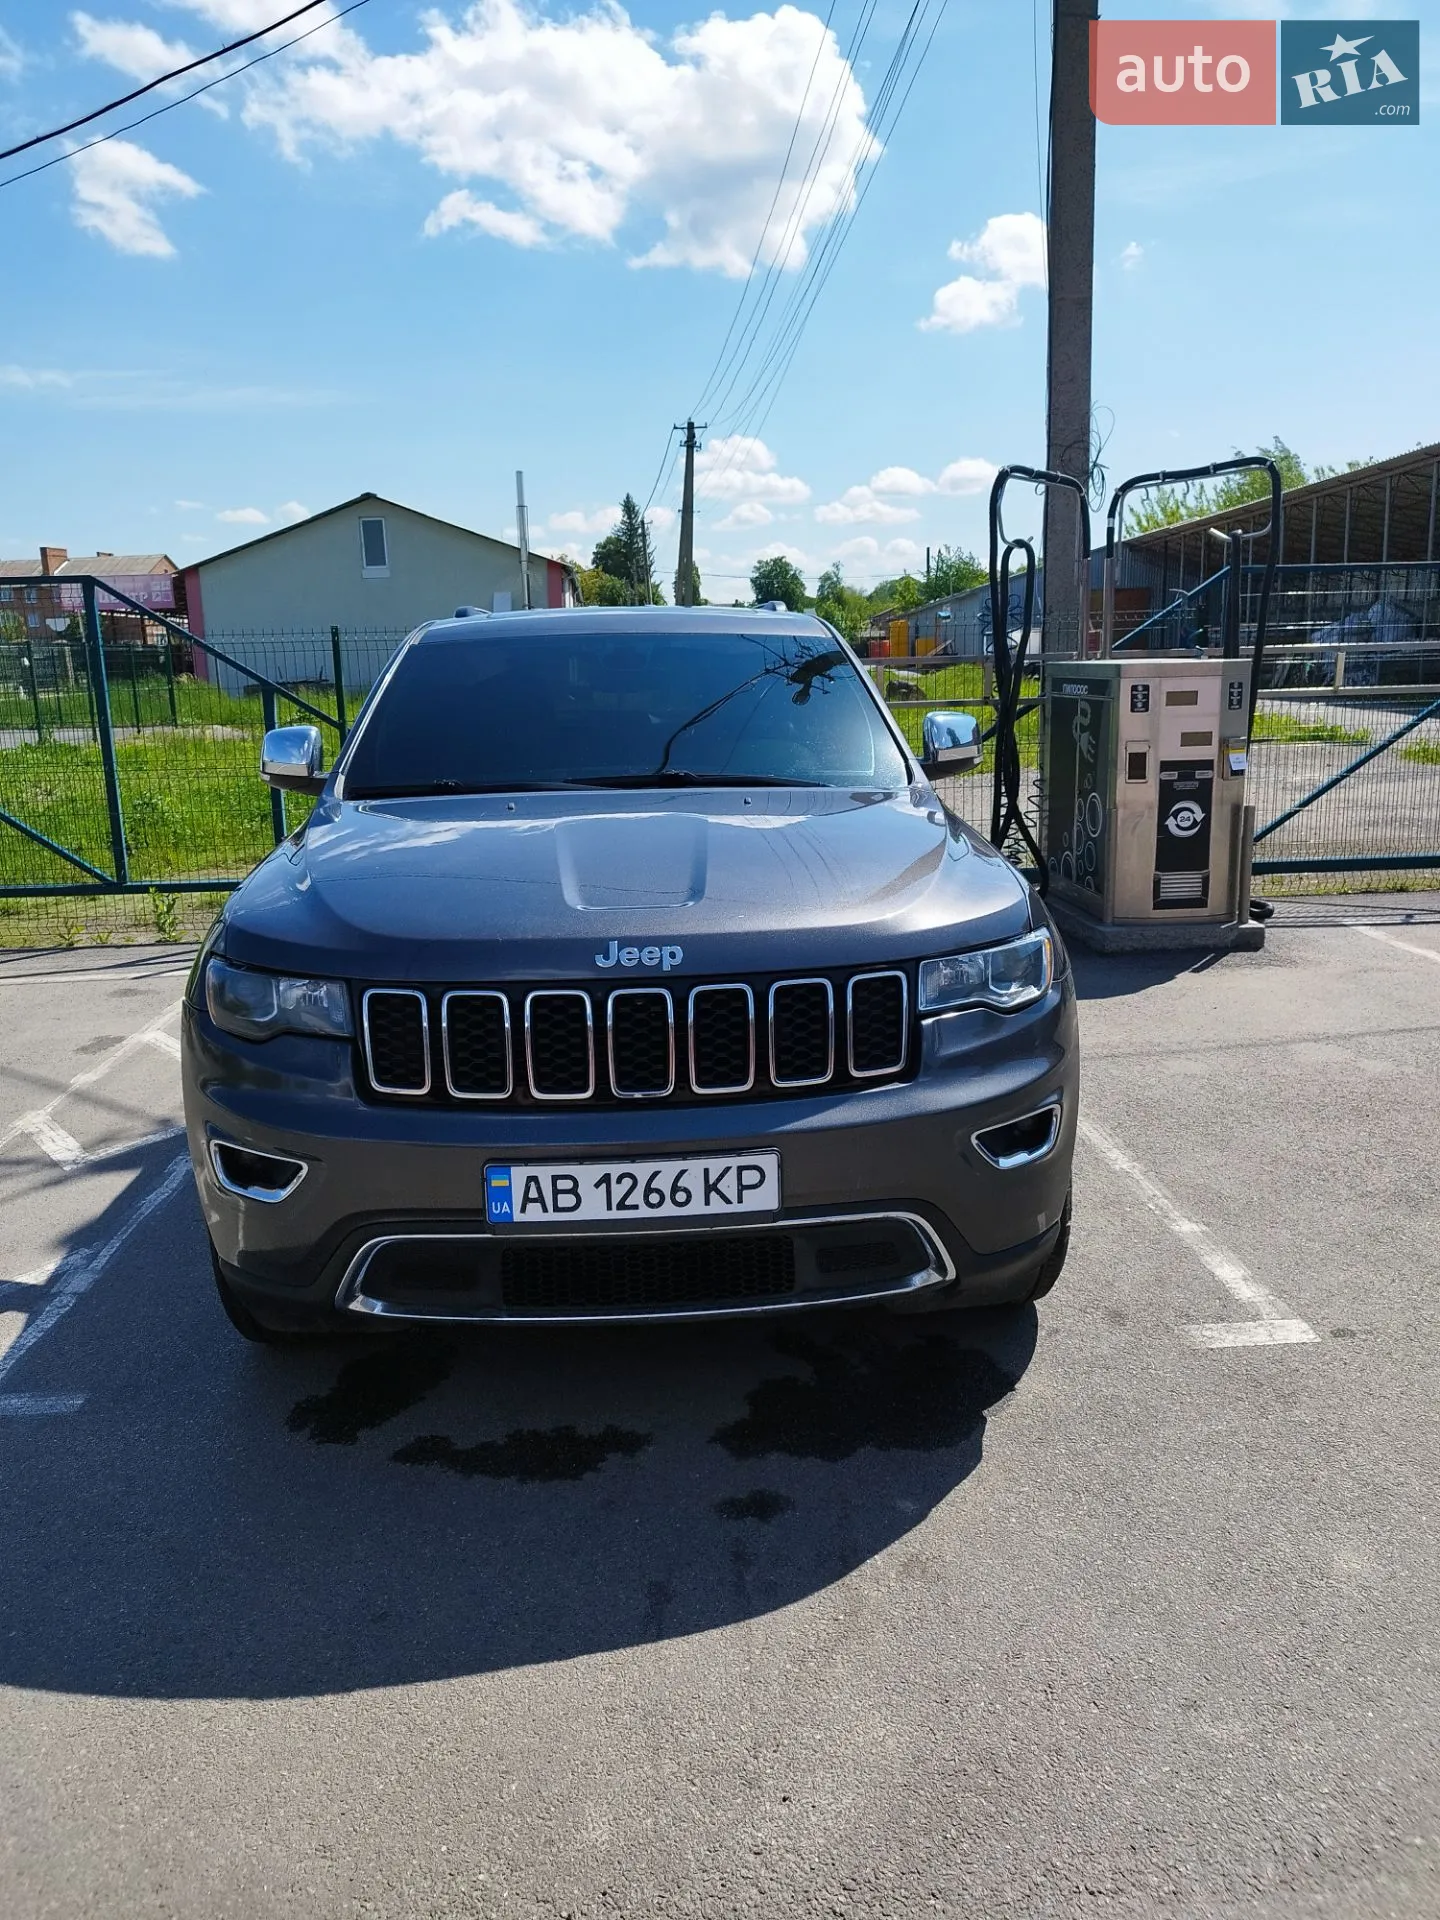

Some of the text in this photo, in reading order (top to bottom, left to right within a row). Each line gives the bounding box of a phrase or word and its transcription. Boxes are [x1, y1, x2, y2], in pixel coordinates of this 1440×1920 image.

[1179, 815, 1191, 823] 24
[594, 940, 684, 971] Jeep
[519, 1164, 766, 1214] AB 1266 KP
[492, 1201, 511, 1214] UA
